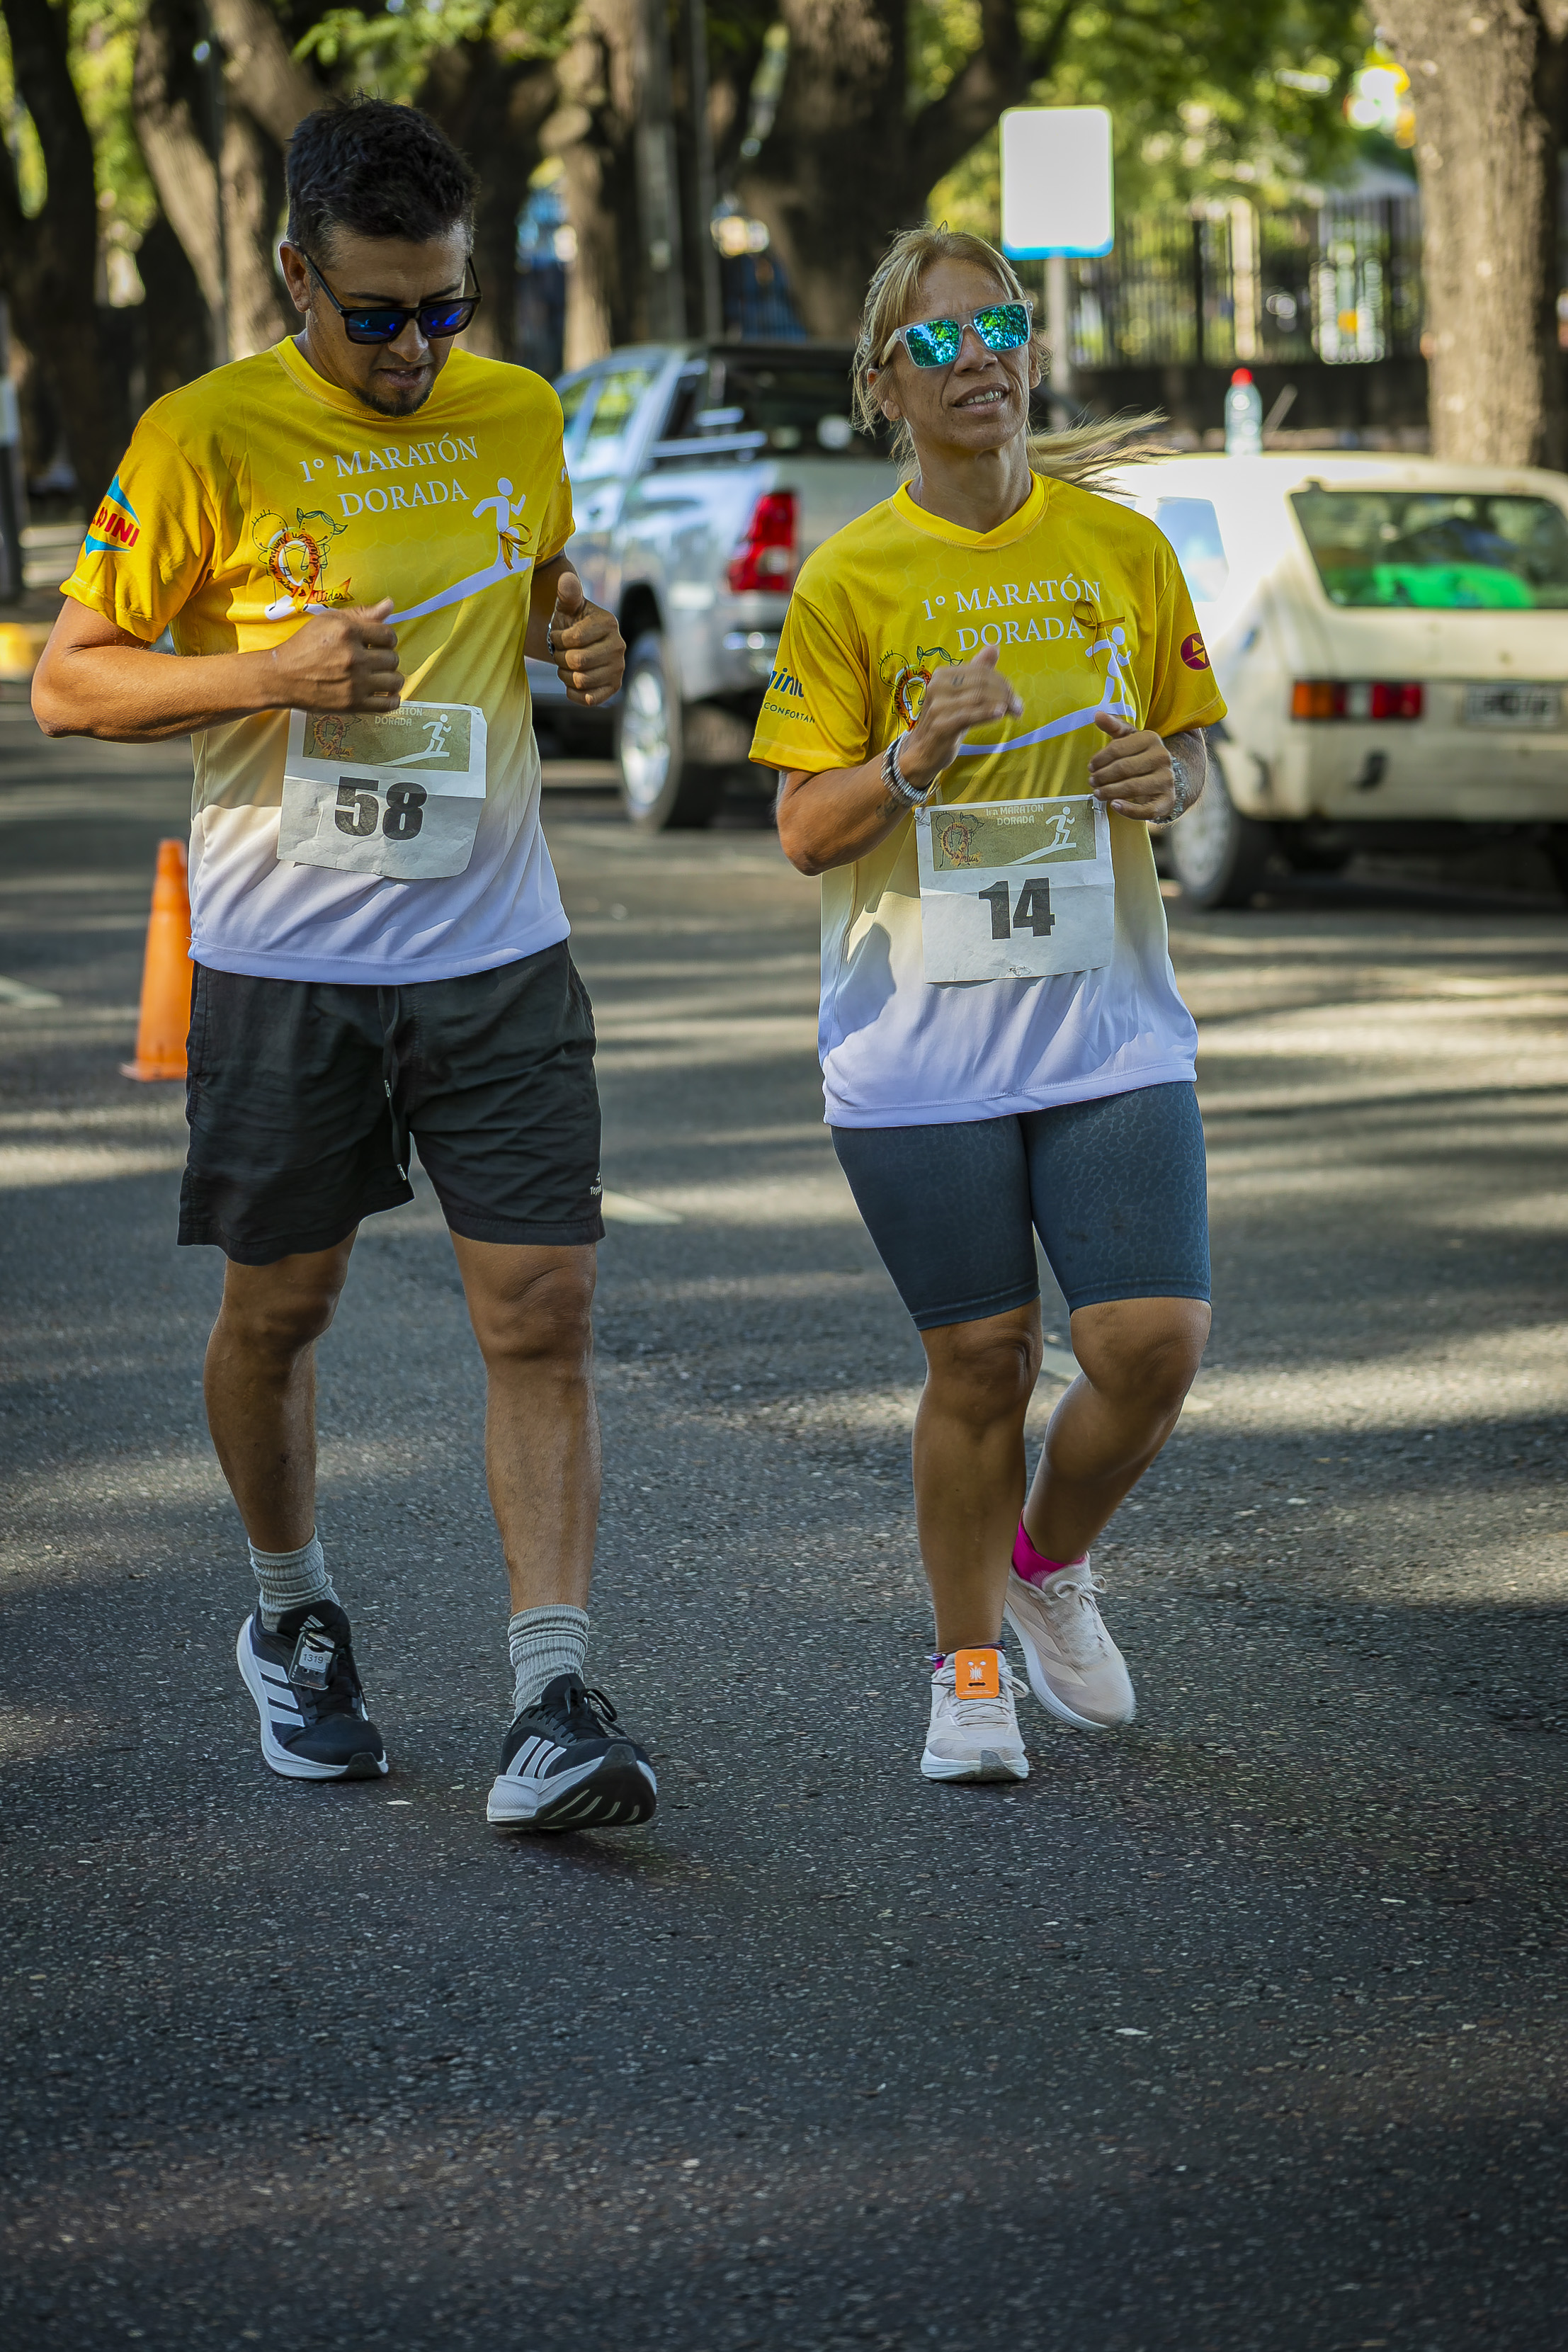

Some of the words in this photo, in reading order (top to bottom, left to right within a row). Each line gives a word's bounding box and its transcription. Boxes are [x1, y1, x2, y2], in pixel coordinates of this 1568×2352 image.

[333, 431, 479, 477] MARATÓN
[337, 478, 470, 517] DORADA
[954, 573, 1101, 613] MARATÓN
[956, 616, 1086, 652] DORADA
[375, 715, 412, 726] DORADA
[334, 776, 428, 841] 58
[996, 814, 1035, 826] DORADA
[999, 804, 1045, 816] MARATON
[978, 877, 1056, 940] 14
[303, 1654, 324, 1664] 1319
